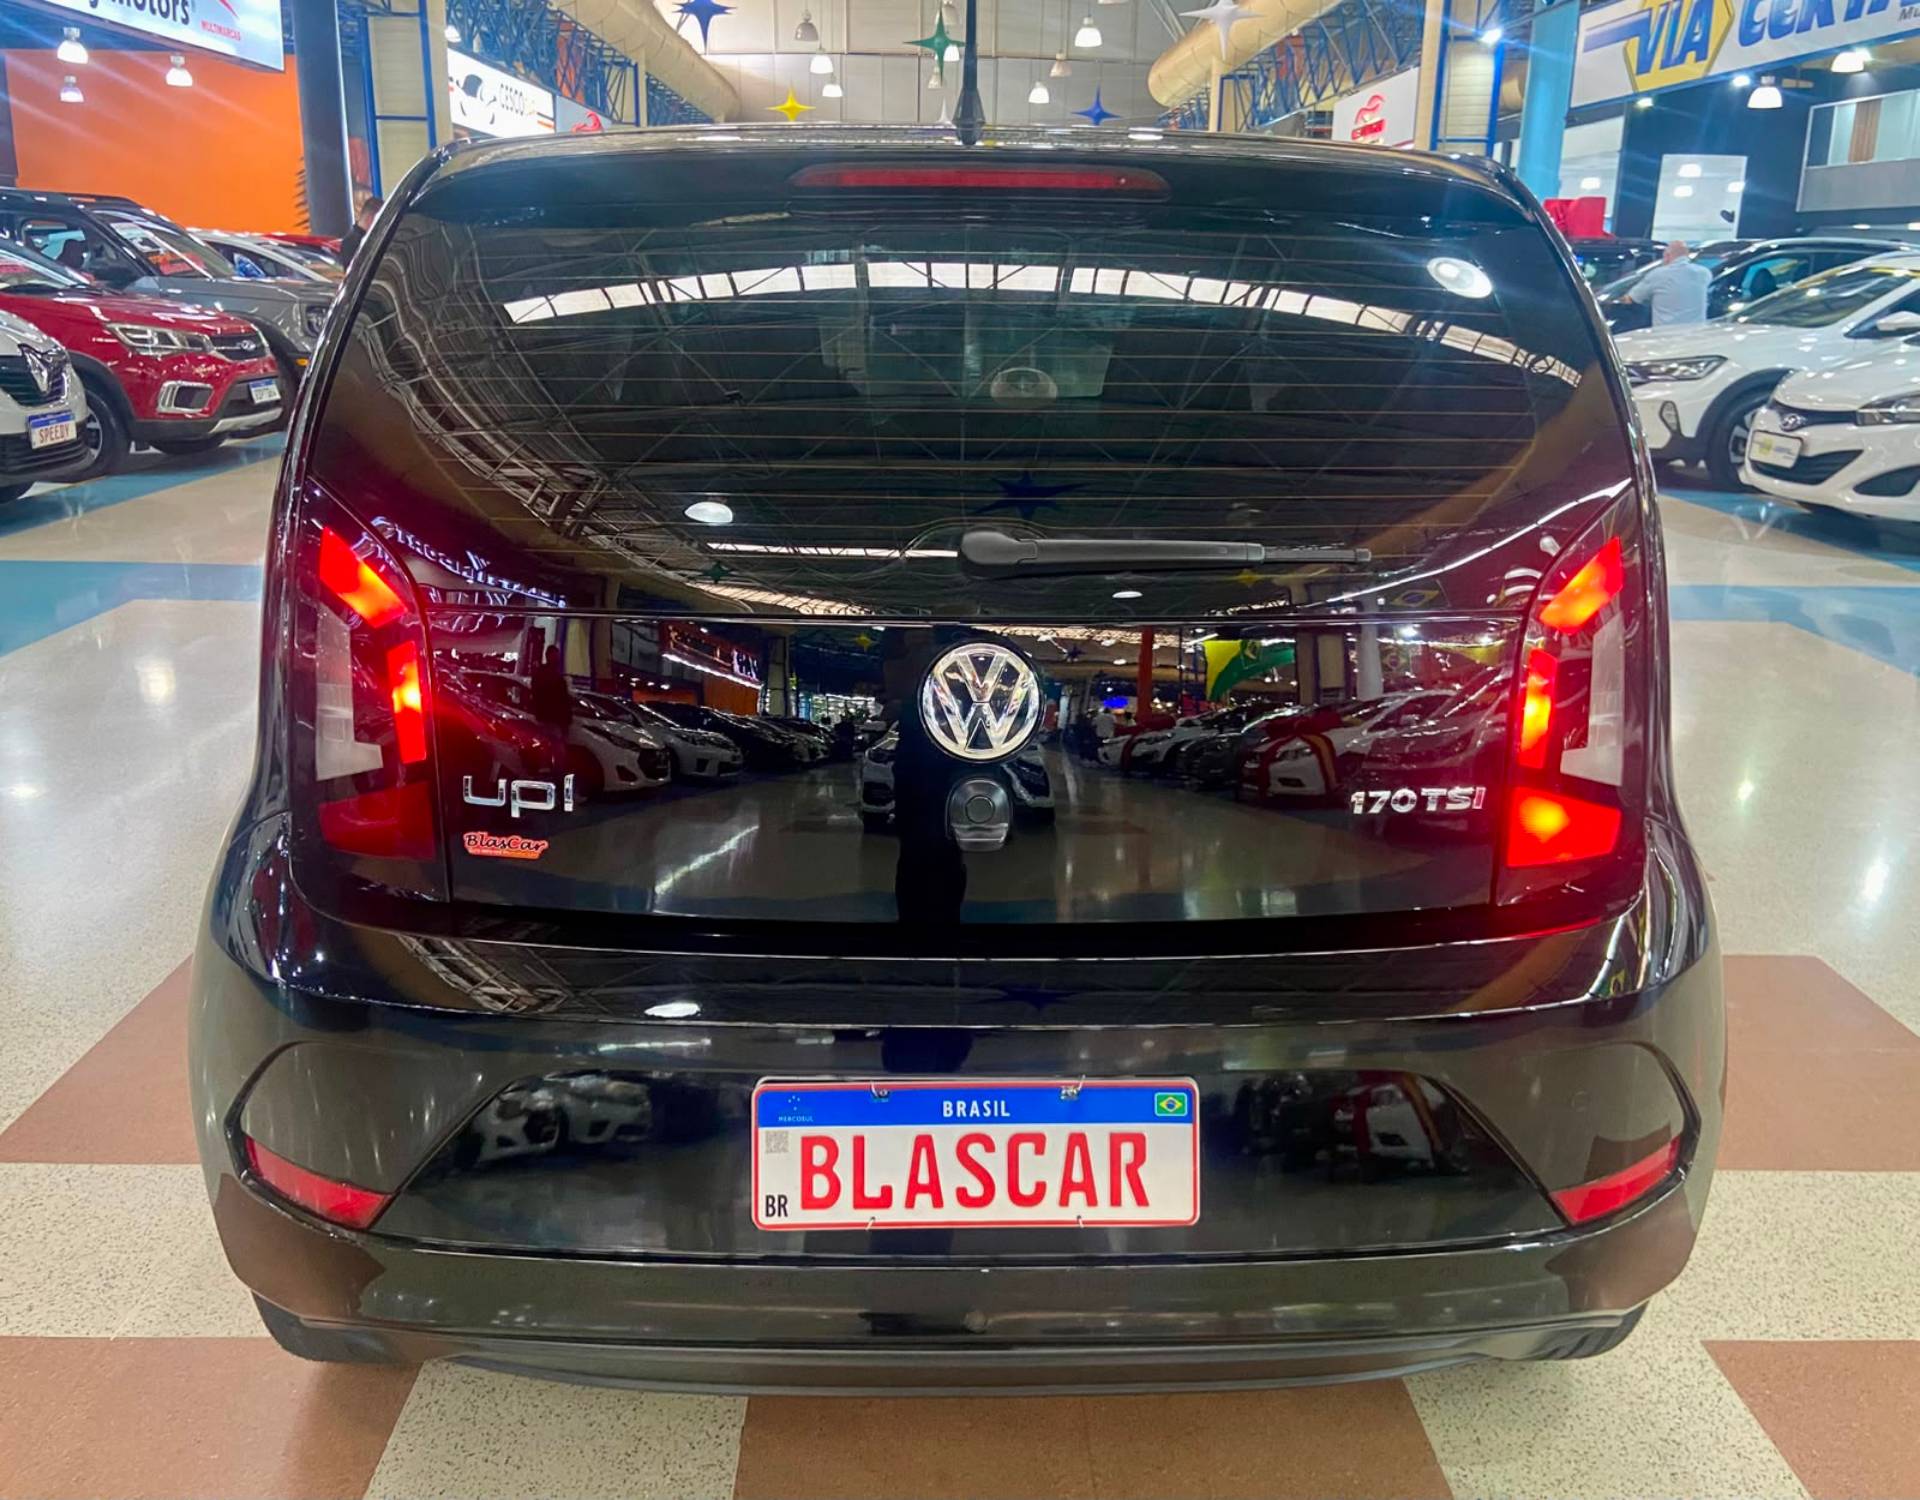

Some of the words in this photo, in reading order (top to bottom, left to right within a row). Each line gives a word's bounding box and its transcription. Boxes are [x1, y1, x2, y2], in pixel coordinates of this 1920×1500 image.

[1584, 0, 1714, 76] VIA
[463, 774, 574, 818] up!
[465, 833, 546, 852] BlasCar
[943, 1100, 1010, 1117] BRASIL
[801, 1132, 1149, 1210] BLASCAR
[765, 1194, 788, 1217] BR
